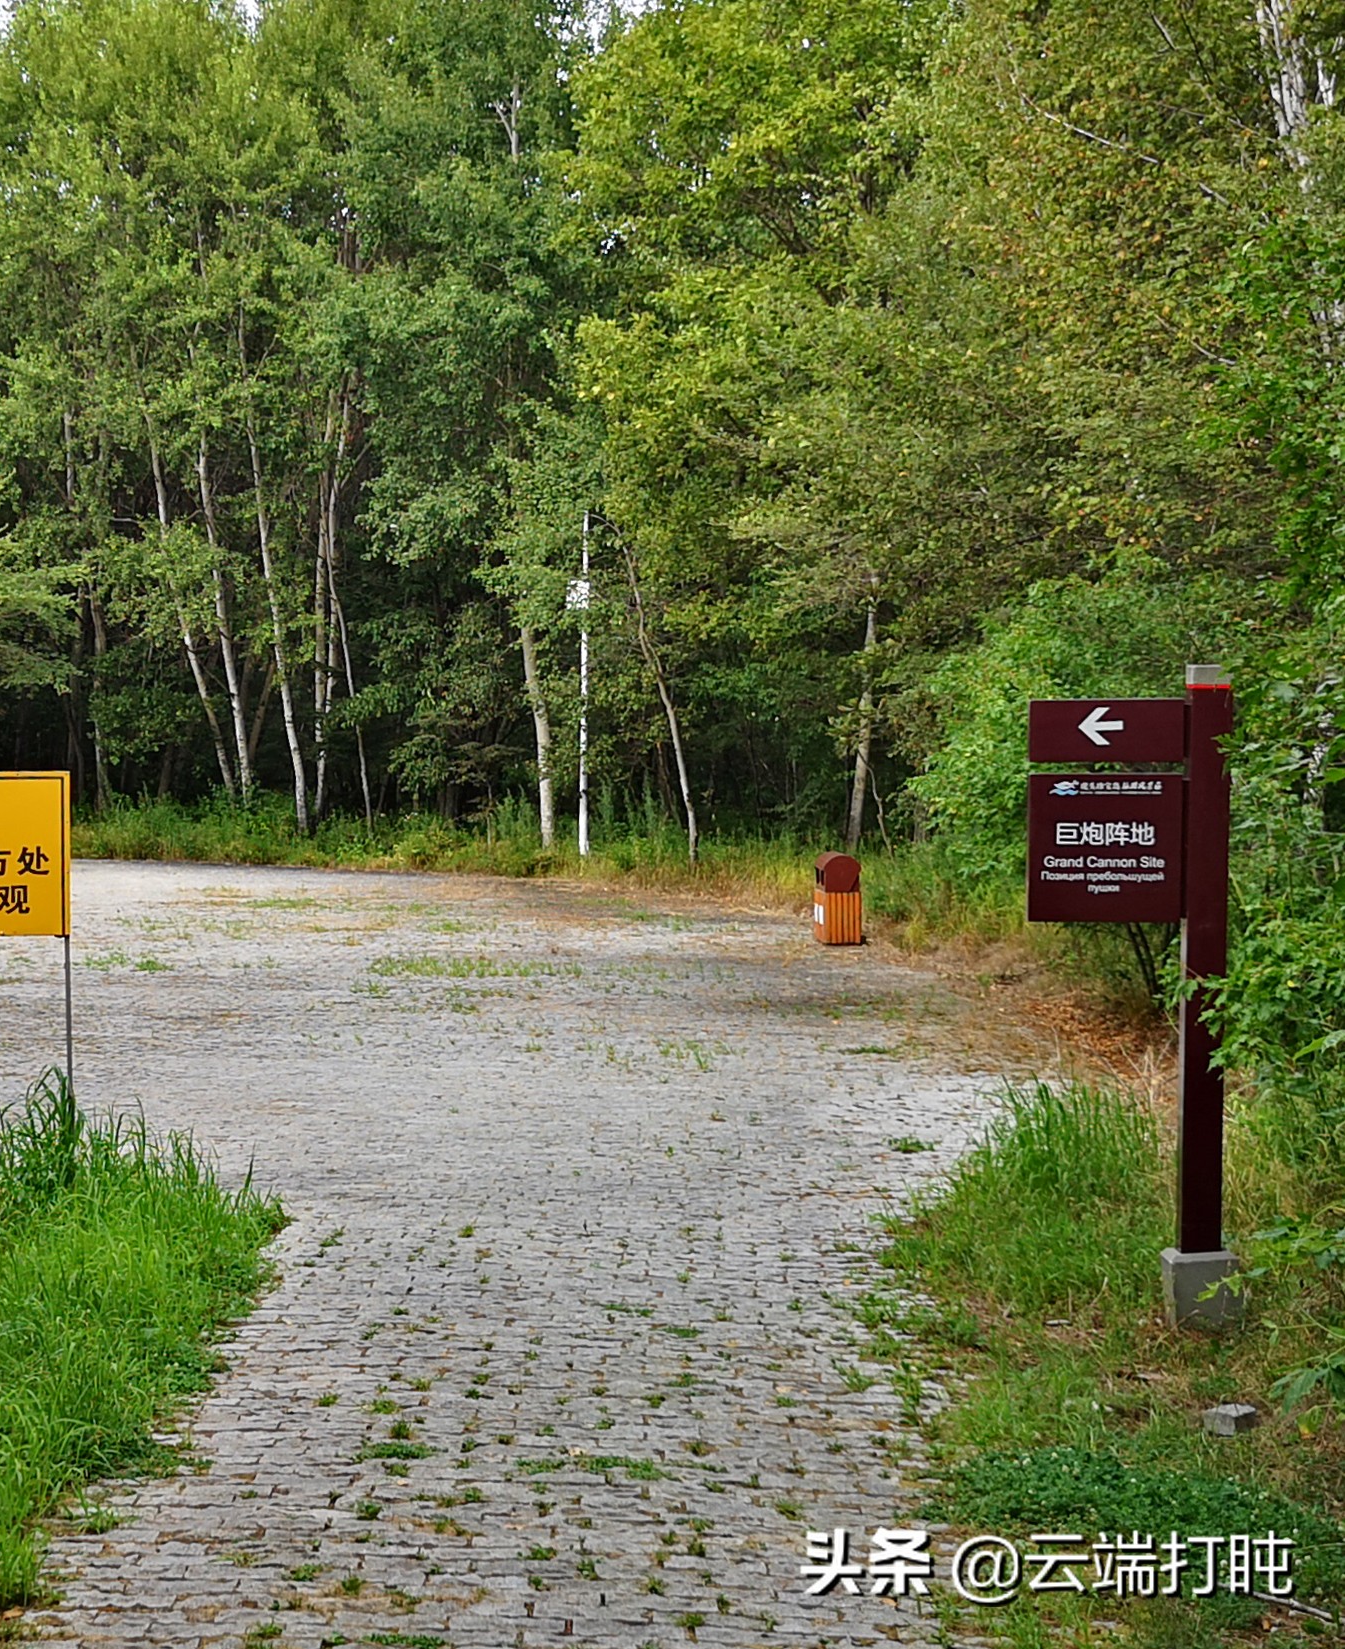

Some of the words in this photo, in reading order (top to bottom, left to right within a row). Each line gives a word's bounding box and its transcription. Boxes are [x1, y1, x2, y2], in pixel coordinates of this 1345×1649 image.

[1055, 822, 1156, 847] 巨炮阵地
[1043, 855, 1083, 868] Grand
[1086, 855, 1137, 868] Cannon
[1139, 855, 1165, 868] Site
